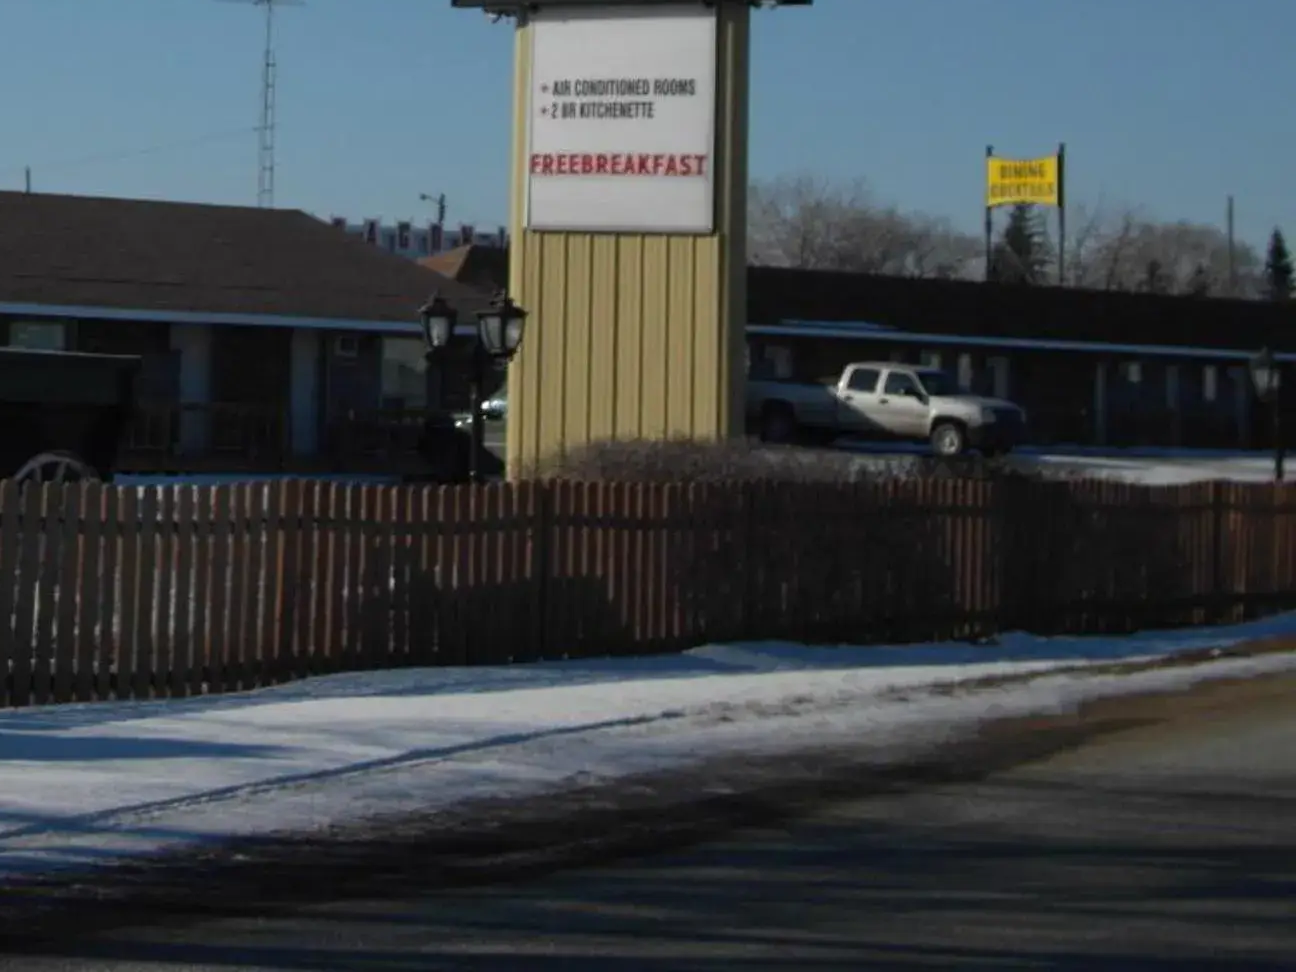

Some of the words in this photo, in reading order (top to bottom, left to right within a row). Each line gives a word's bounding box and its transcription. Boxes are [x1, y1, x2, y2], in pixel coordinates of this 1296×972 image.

[552, 79, 572, 96] AIR
[574, 78, 650, 96] CONDITIONED
[654, 78, 696, 96] ROOMS
[551, 101, 558, 119] 2
[579, 101, 655, 119] KITCHENETTE
[530, 153, 708, 176] FREEBREAKFAST
